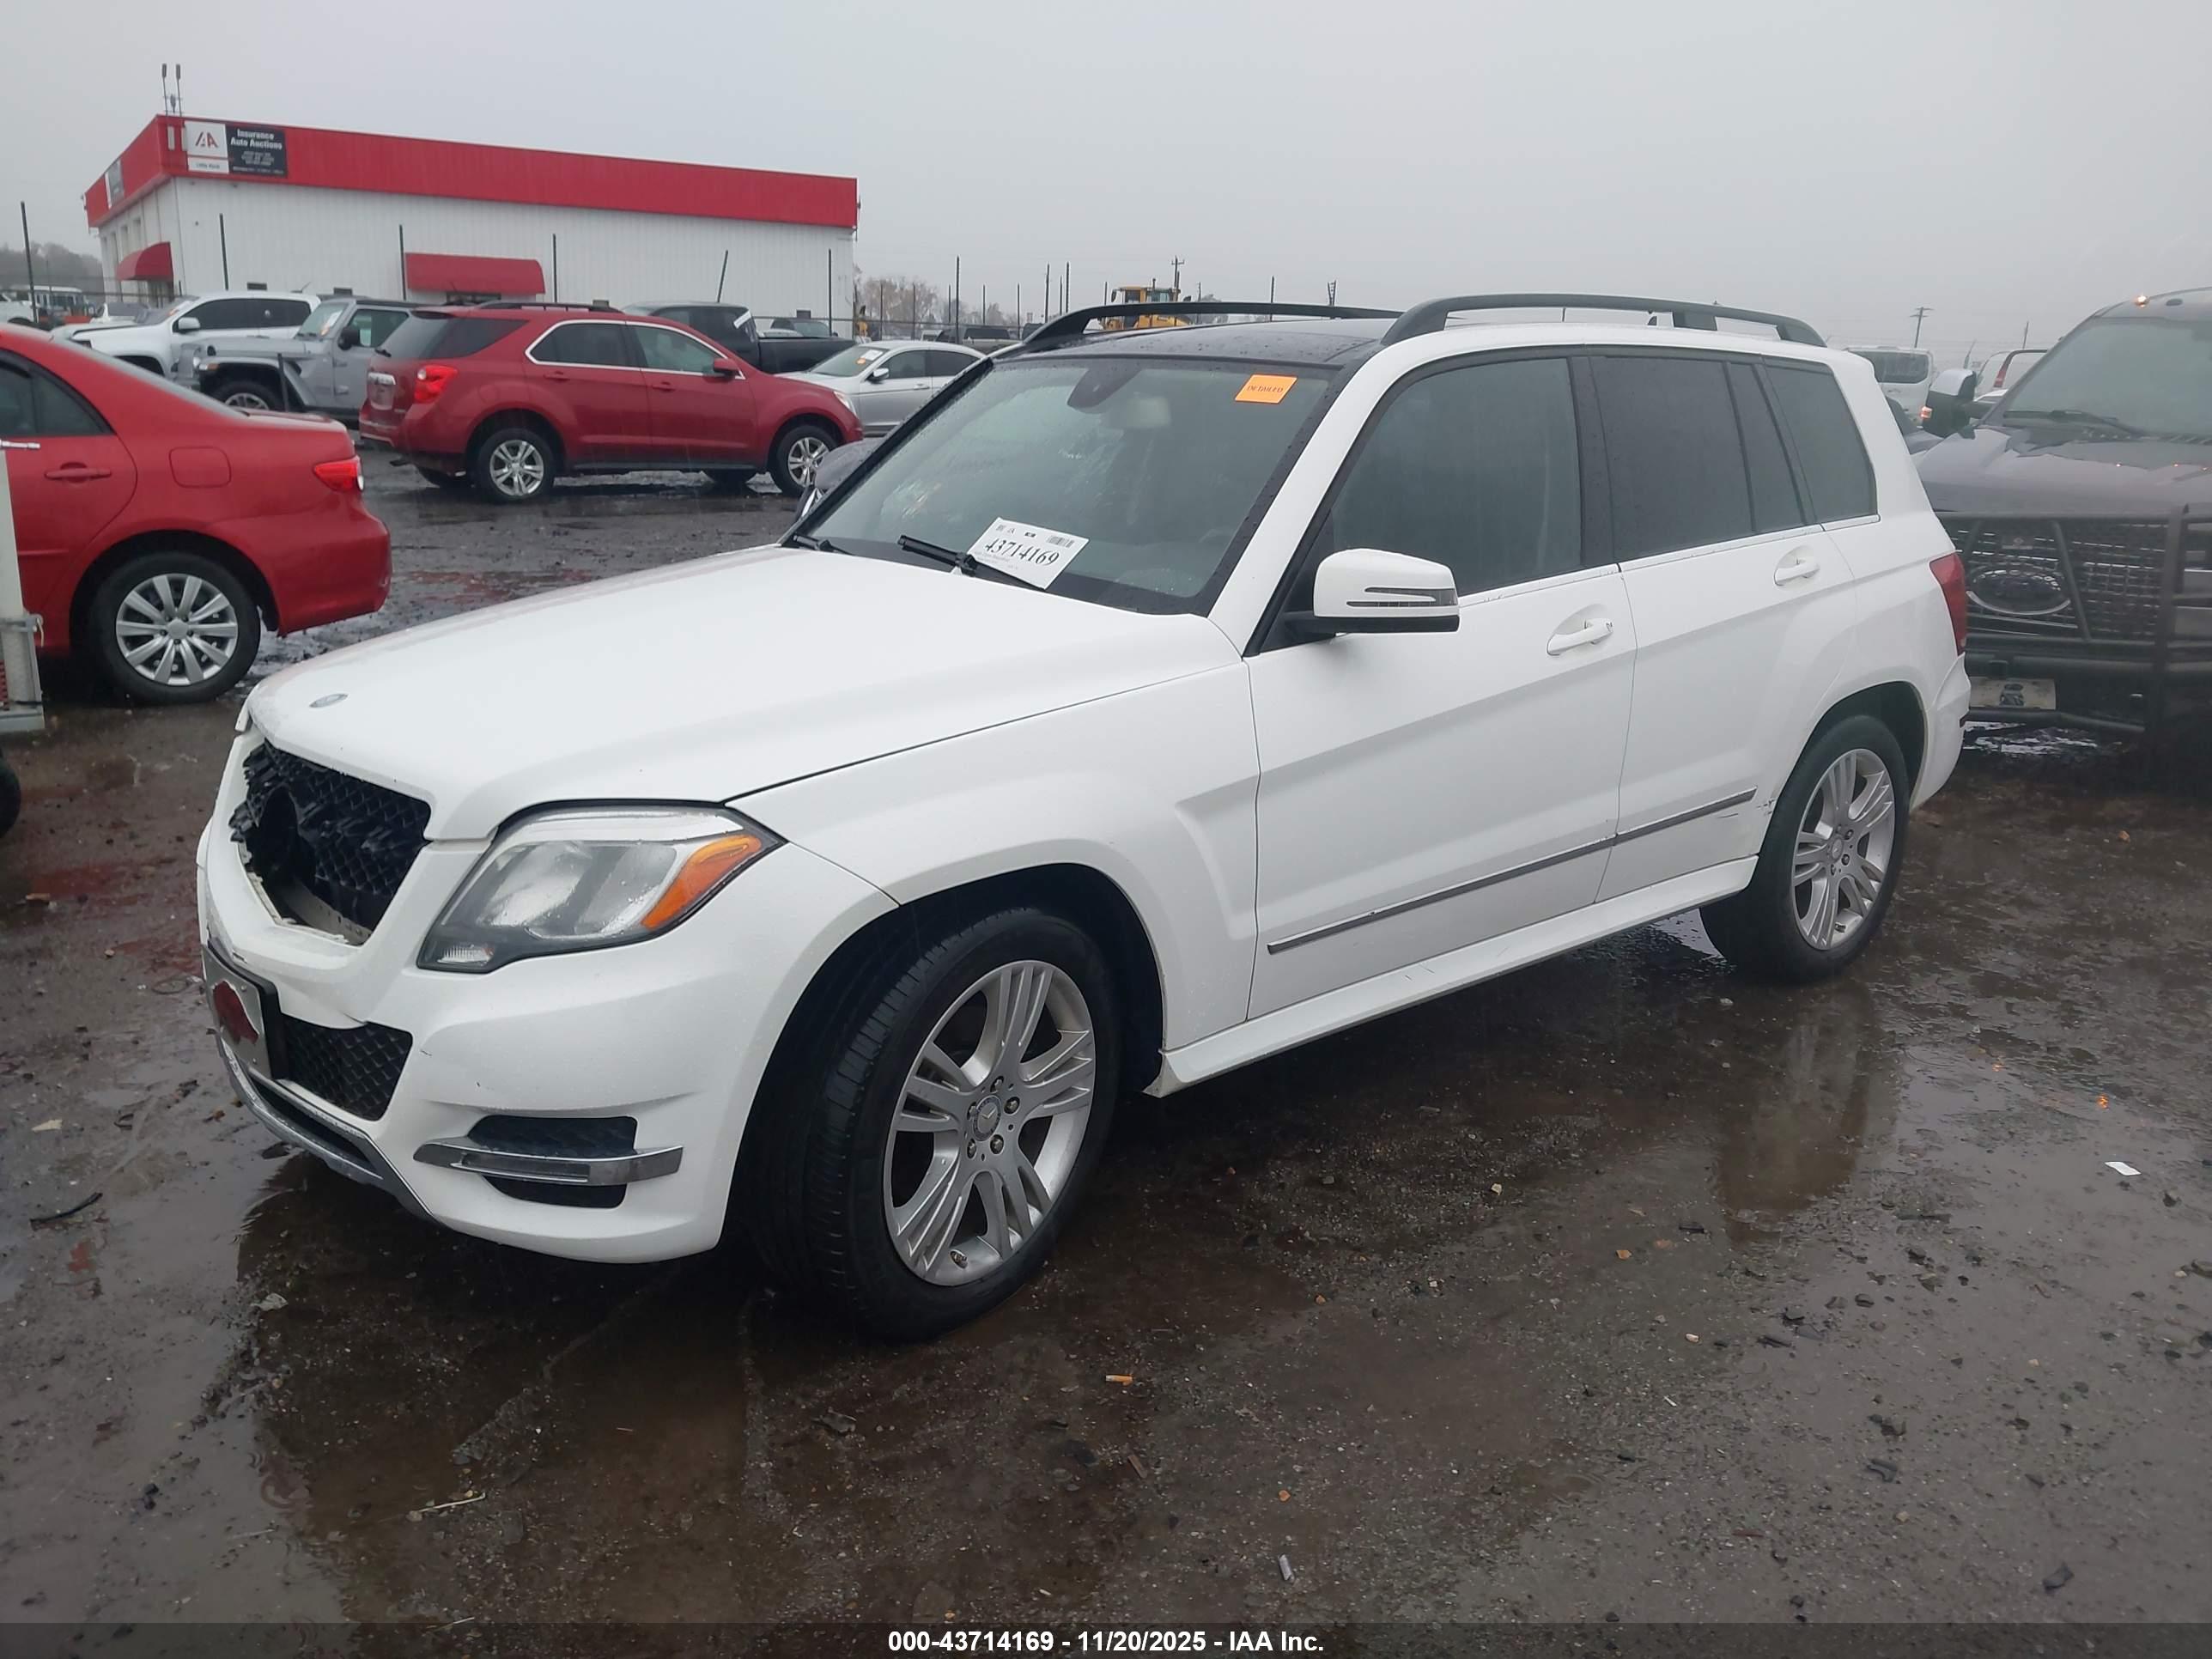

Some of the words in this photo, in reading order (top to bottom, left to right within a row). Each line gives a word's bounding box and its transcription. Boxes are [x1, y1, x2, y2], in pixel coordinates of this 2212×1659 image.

[237, 129, 275, 139] Insurance
[230, 137, 248, 147] Auto
[249, 138, 283, 149] Auctions
[985, 538, 1060, 566] 43714169
